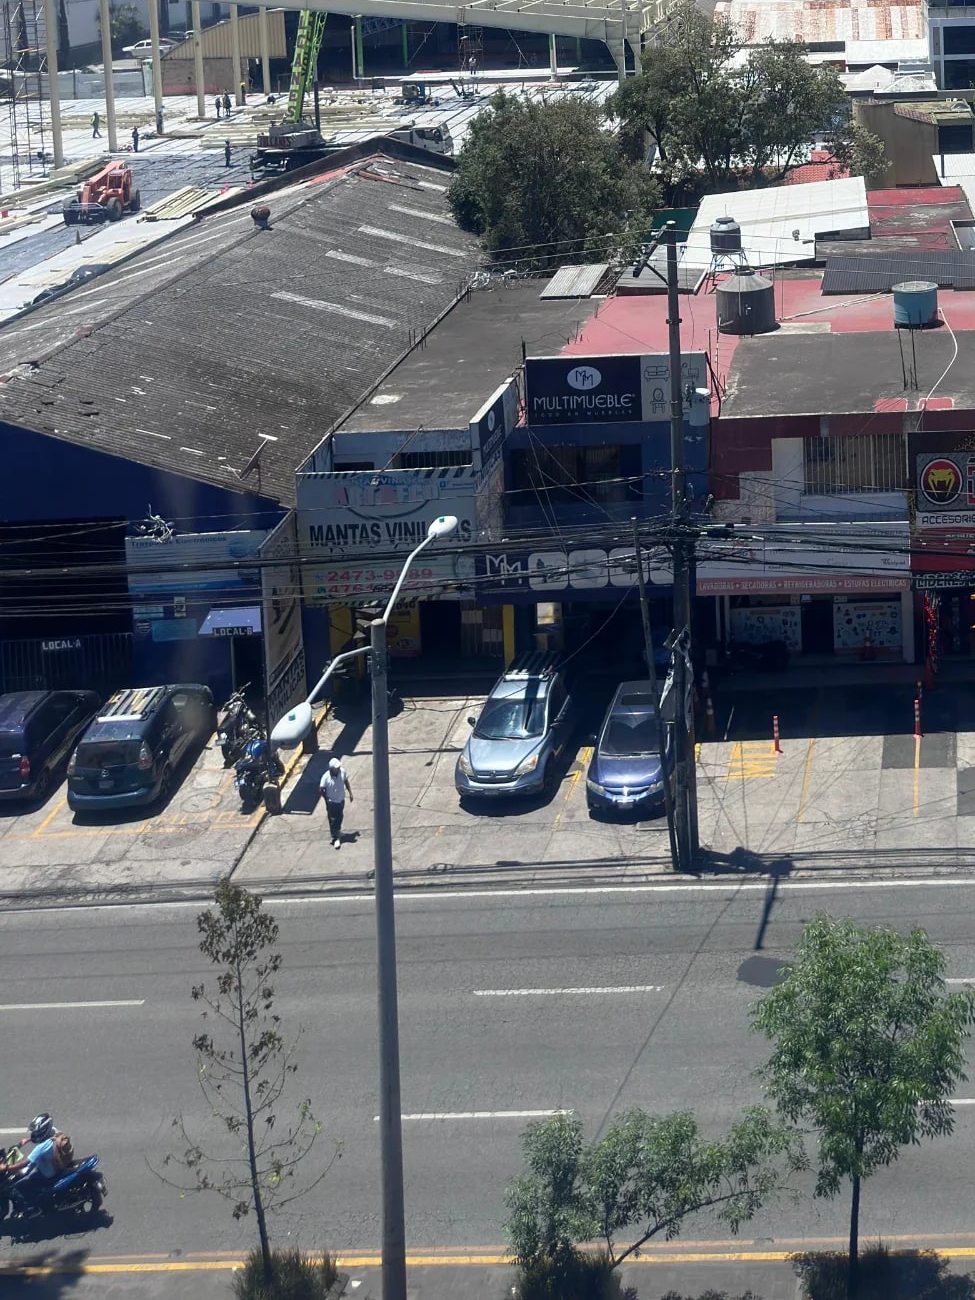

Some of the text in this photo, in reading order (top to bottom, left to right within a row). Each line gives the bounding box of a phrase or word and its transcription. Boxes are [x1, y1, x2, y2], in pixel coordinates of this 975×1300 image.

[533, 393, 633, 411] MULTIMUEBLE
[309, 522, 382, 547] MANTAS
[783, 579, 838, 589] REFRIGERADORAS
[843, 579, 870, 588] ESTUFAS
